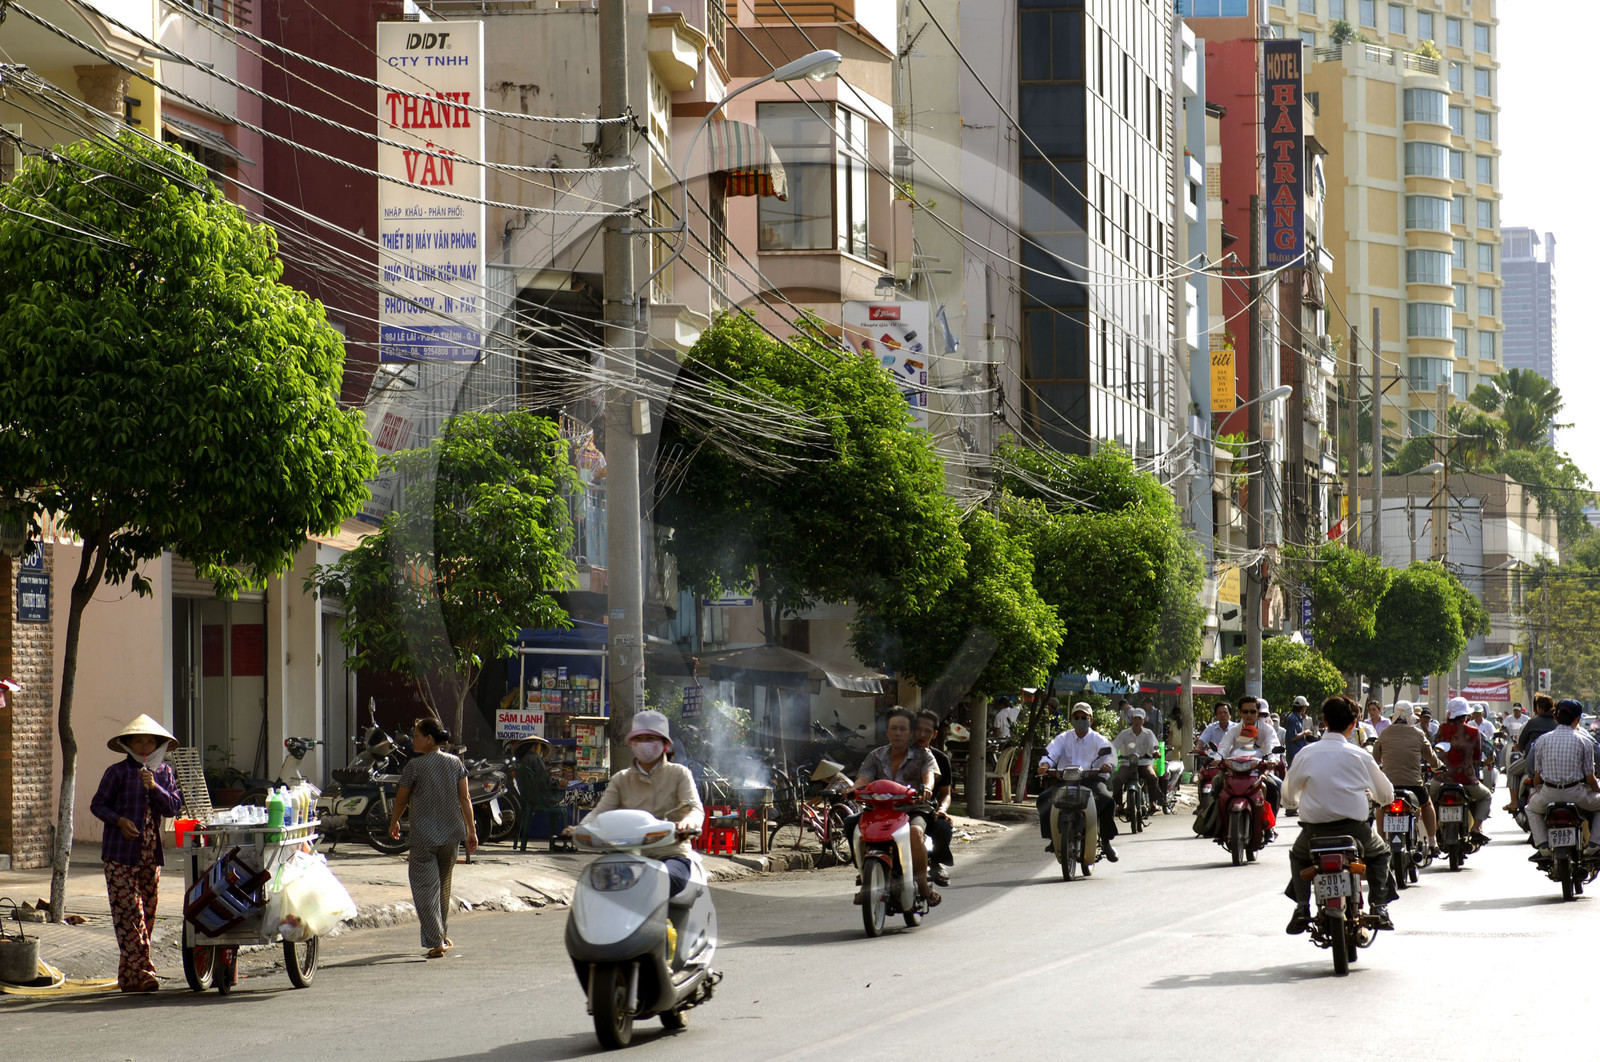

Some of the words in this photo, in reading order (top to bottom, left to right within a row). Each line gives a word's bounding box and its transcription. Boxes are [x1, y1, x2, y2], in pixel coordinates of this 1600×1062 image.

[388, 56, 419, 66] CTY
[425, 56, 468, 66] TNHH
[1267, 53, 1299, 80] HOTEL
[386, 92, 470, 128] THANH
[1272, 140, 1297, 249] TRANG
[385, 206, 402, 218] NHẬP
[429, 205, 446, 216] PHÂN
[382, 228, 404, 249] THIẾT
[406, 233, 414, 253] BỊ
[416, 229, 431, 249] MÁY
[434, 230, 448, 249] VĂN
[451, 229, 476, 249] PHÒNG
[460, 261, 477, 281] MÁY
[385, 297, 435, 314] PHOTOCOPY
[444, 297, 453, 313] IN
[460, 297, 476, 313] FAX
[499, 712, 518, 723] SÂM
